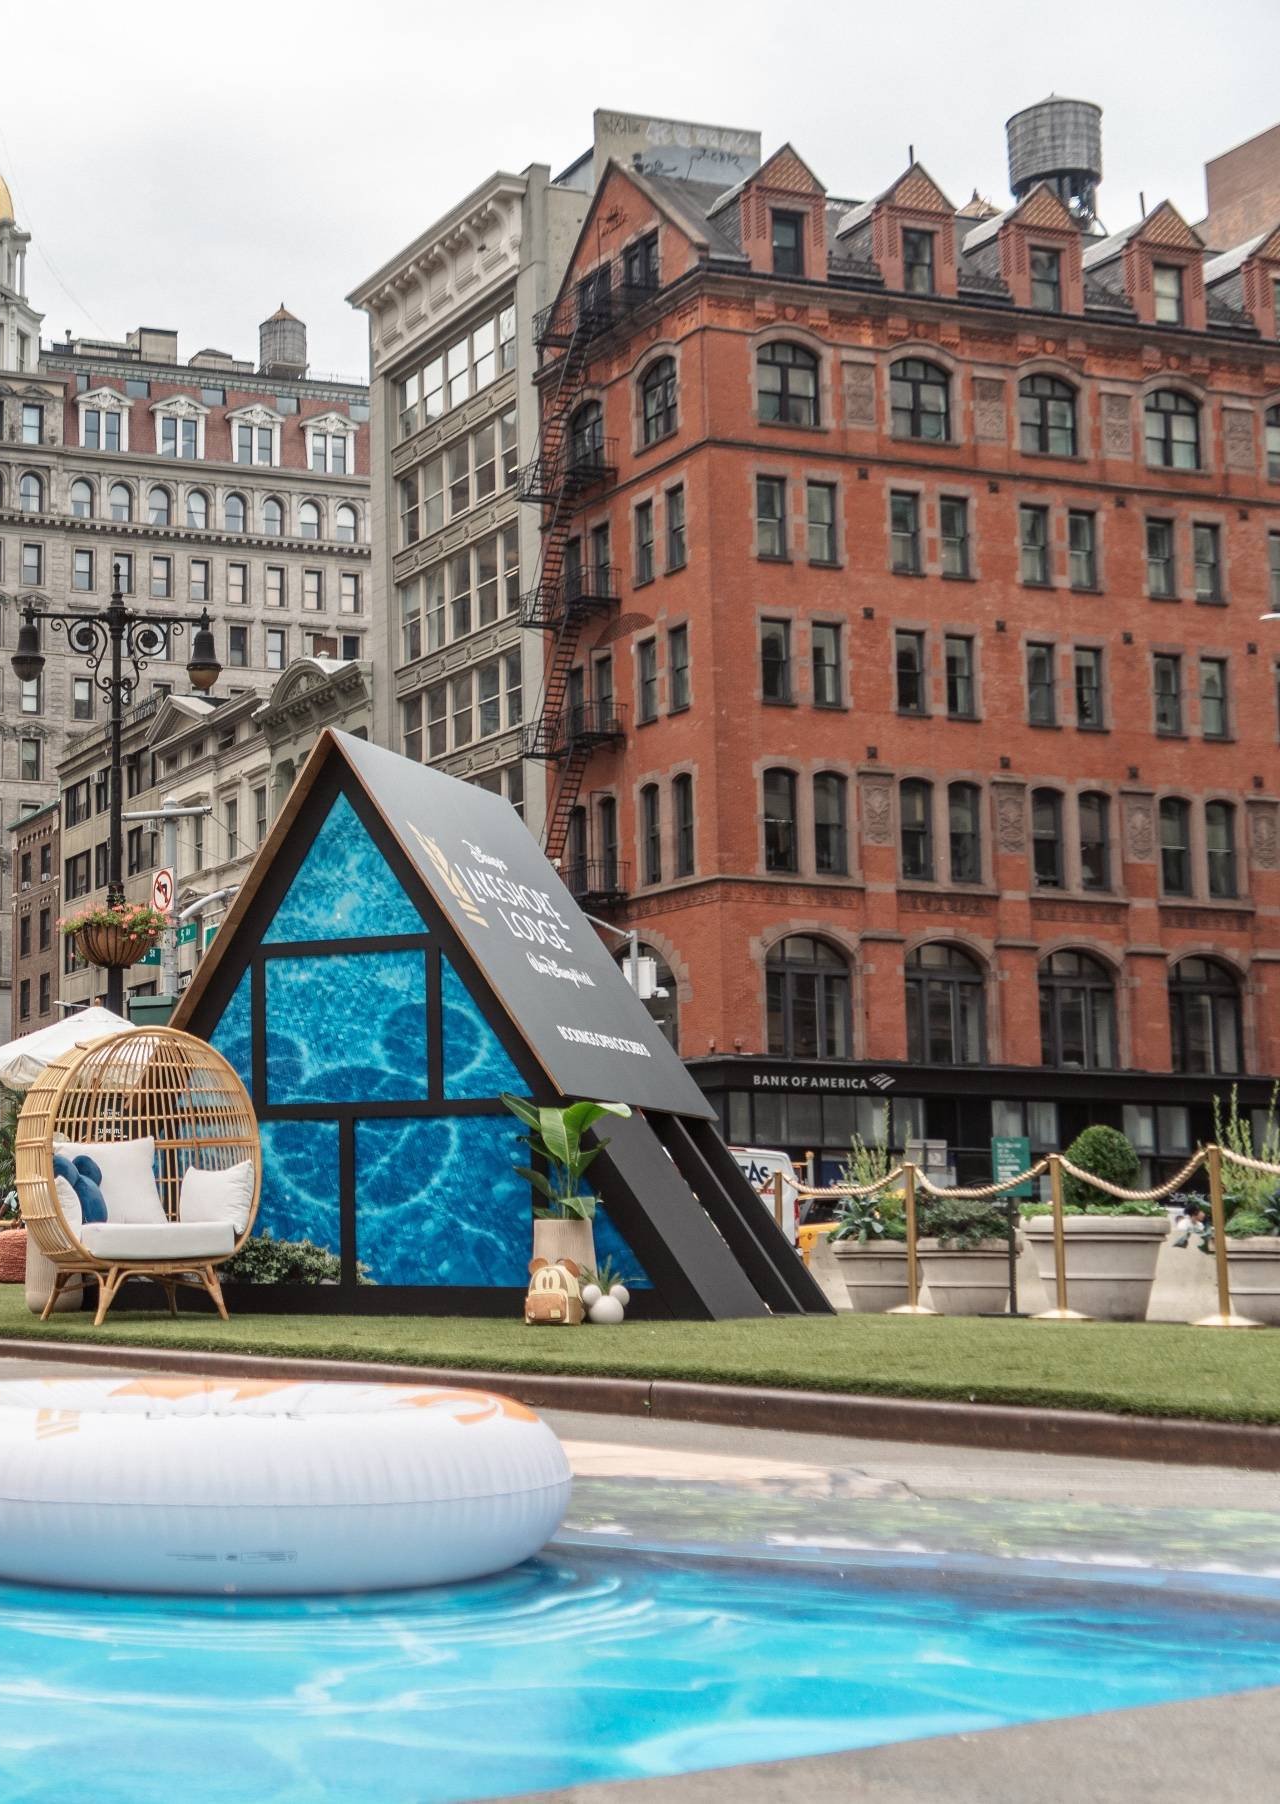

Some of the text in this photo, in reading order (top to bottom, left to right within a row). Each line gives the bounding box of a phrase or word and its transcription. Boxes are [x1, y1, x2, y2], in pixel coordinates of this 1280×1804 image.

[454, 863, 570, 930] LAKESHORE
[180, 928, 186, 943] 5
[497, 907, 573, 953] LODGE
[753, 1075, 868, 1089] BANK OF AMERICA
